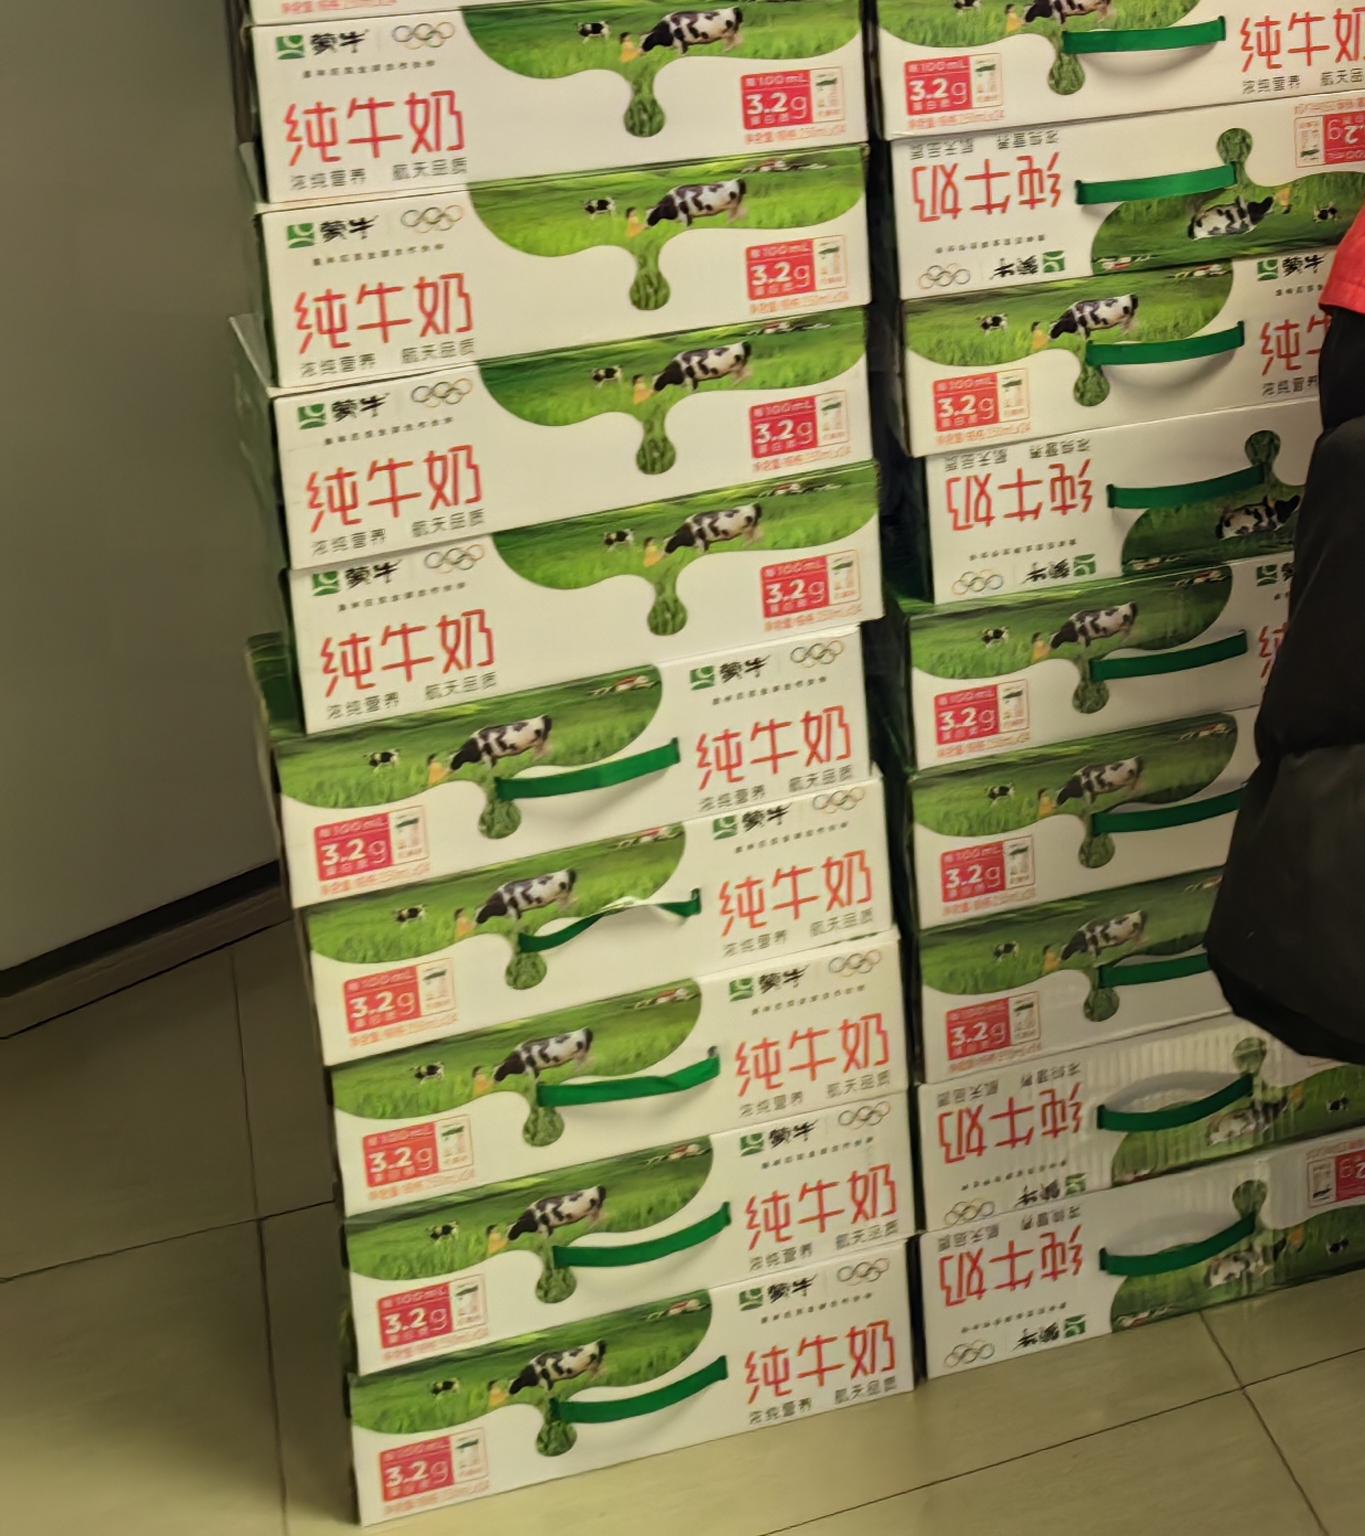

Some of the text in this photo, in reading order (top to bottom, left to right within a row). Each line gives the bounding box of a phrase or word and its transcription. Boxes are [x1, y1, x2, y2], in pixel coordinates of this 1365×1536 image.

[311, 32, 364, 55] 蒙牛
[909, 77, 968, 103] 3.2g
[746, 92, 807, 122] 3.2g
[284, 90, 465, 166] 纯牛奶
[912, 153, 1061, 223] 纯牛奶
[320, 218, 373, 242] 蒙牛
[751, 263, 811, 293] 3.2g
[294, 273, 473, 354] 纯牛奶
[332, 396, 385, 421] 蒙牛
[938, 394, 996, 419] 3.2g
[753, 415, 815, 448] 3.2g
[306, 445, 482, 532] 纯牛奶
[946, 460, 1092, 531] 纯牛奶
[346, 562, 397, 588] 蒙牛
[765, 576, 827, 608] 3.2g
[321, 610, 494, 697] 纯牛奶
[720, 658, 766, 682] 蒙牛
[941, 708, 995, 731] 3.2g
[696, 706, 852, 790] 纯牛奶
[742, 806, 788, 831] 蒙牛
[319, 840, 389, 869] 3.2g
[945, 865, 1002, 888] 3.2g
[719, 851, 872, 936] 纯牛奶
[759, 969, 805, 993] 蒙牛
[348, 992, 416, 1020] 3.2g
[950, 1022, 1006, 1045] 3.2g
[735, 1013, 890, 1097] 纯牛奶
[769, 1122, 814, 1147] 蒙牛
[938, 1087, 1081, 1164] 纯牛奶
[368, 1146, 433, 1173] 3.2g
[746, 1165, 897, 1250] 纯牛奶
[939, 1228, 1082, 1307] 纯牛奶
[768, 1278, 814, 1303] 蒙牛
[382, 1307, 448, 1336] 3.2g
[746, 1321, 896, 1402] 纯牛奶
[385, 1460, 450, 1487] 3.2g
